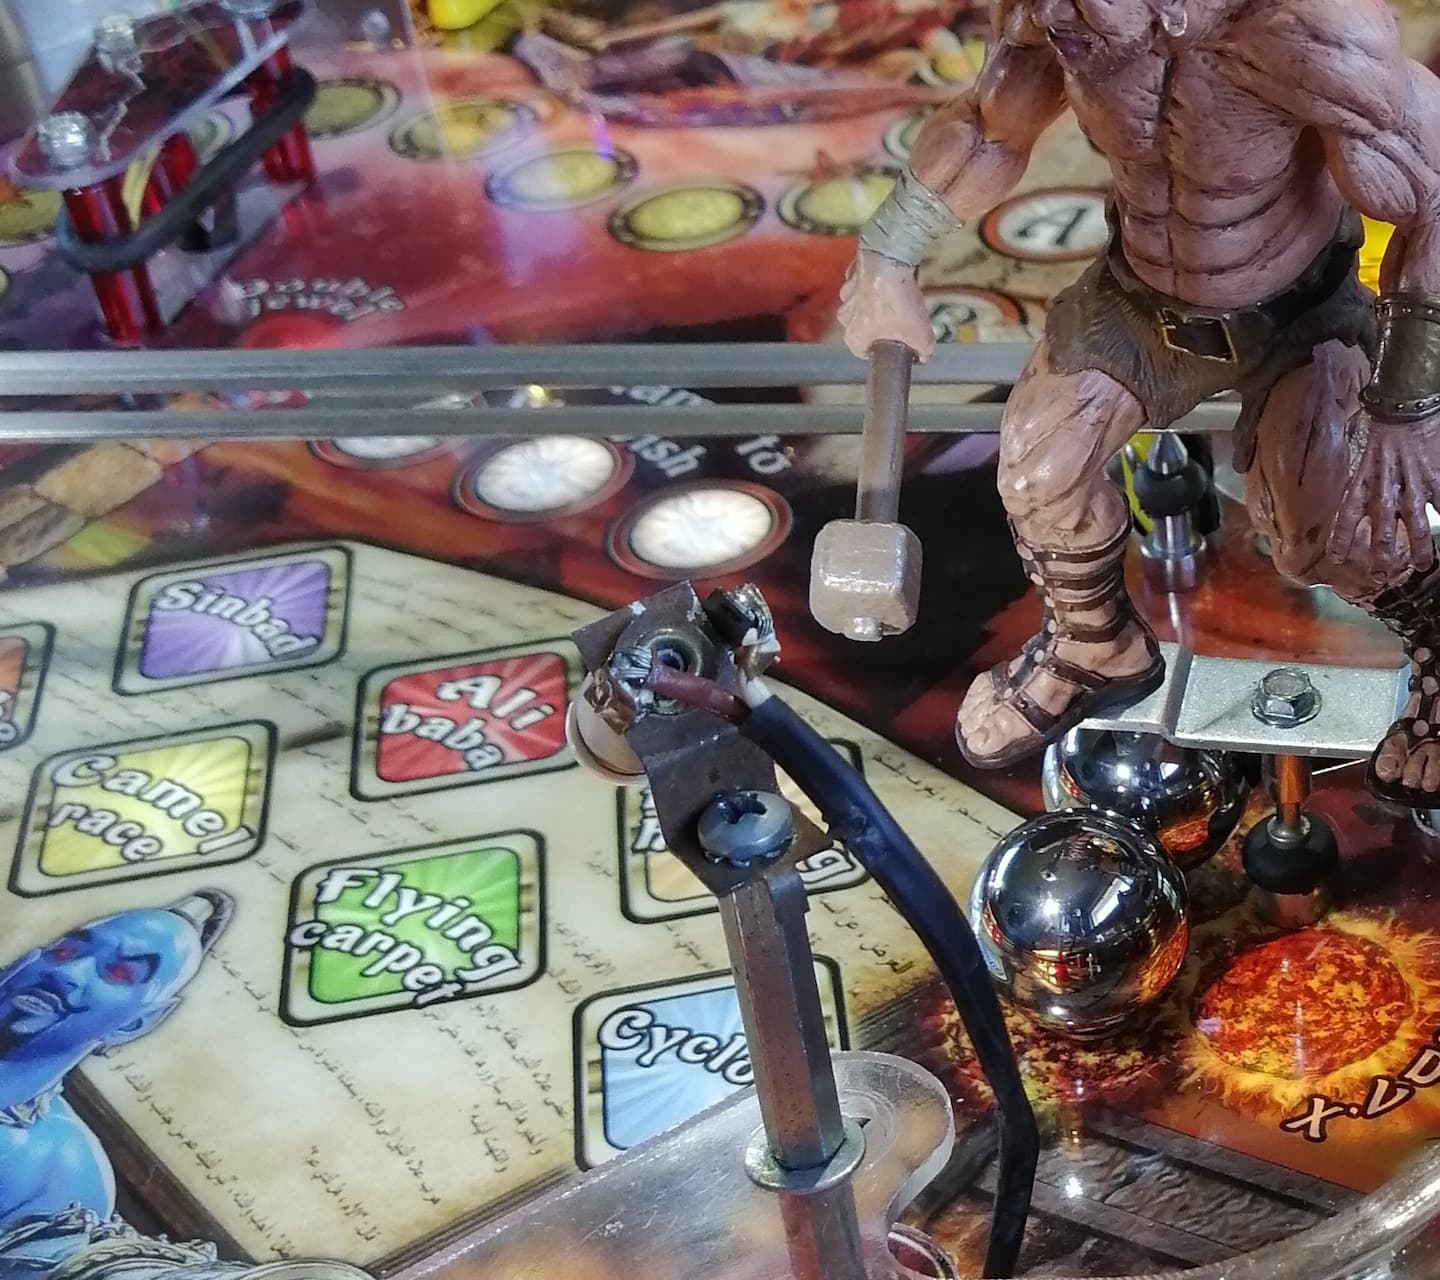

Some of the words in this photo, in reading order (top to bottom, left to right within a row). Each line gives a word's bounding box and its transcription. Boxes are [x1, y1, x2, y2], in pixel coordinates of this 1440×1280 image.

[152, 580, 320, 657] Sinbad
[381, 702, 505, 771] baba
[436, 674, 556, 732] Ali
[50, 802, 163, 862] race
[52, 754, 256, 856] Camel
[314, 866, 523, 984] Flying
[286, 920, 465, 1008] carpet
